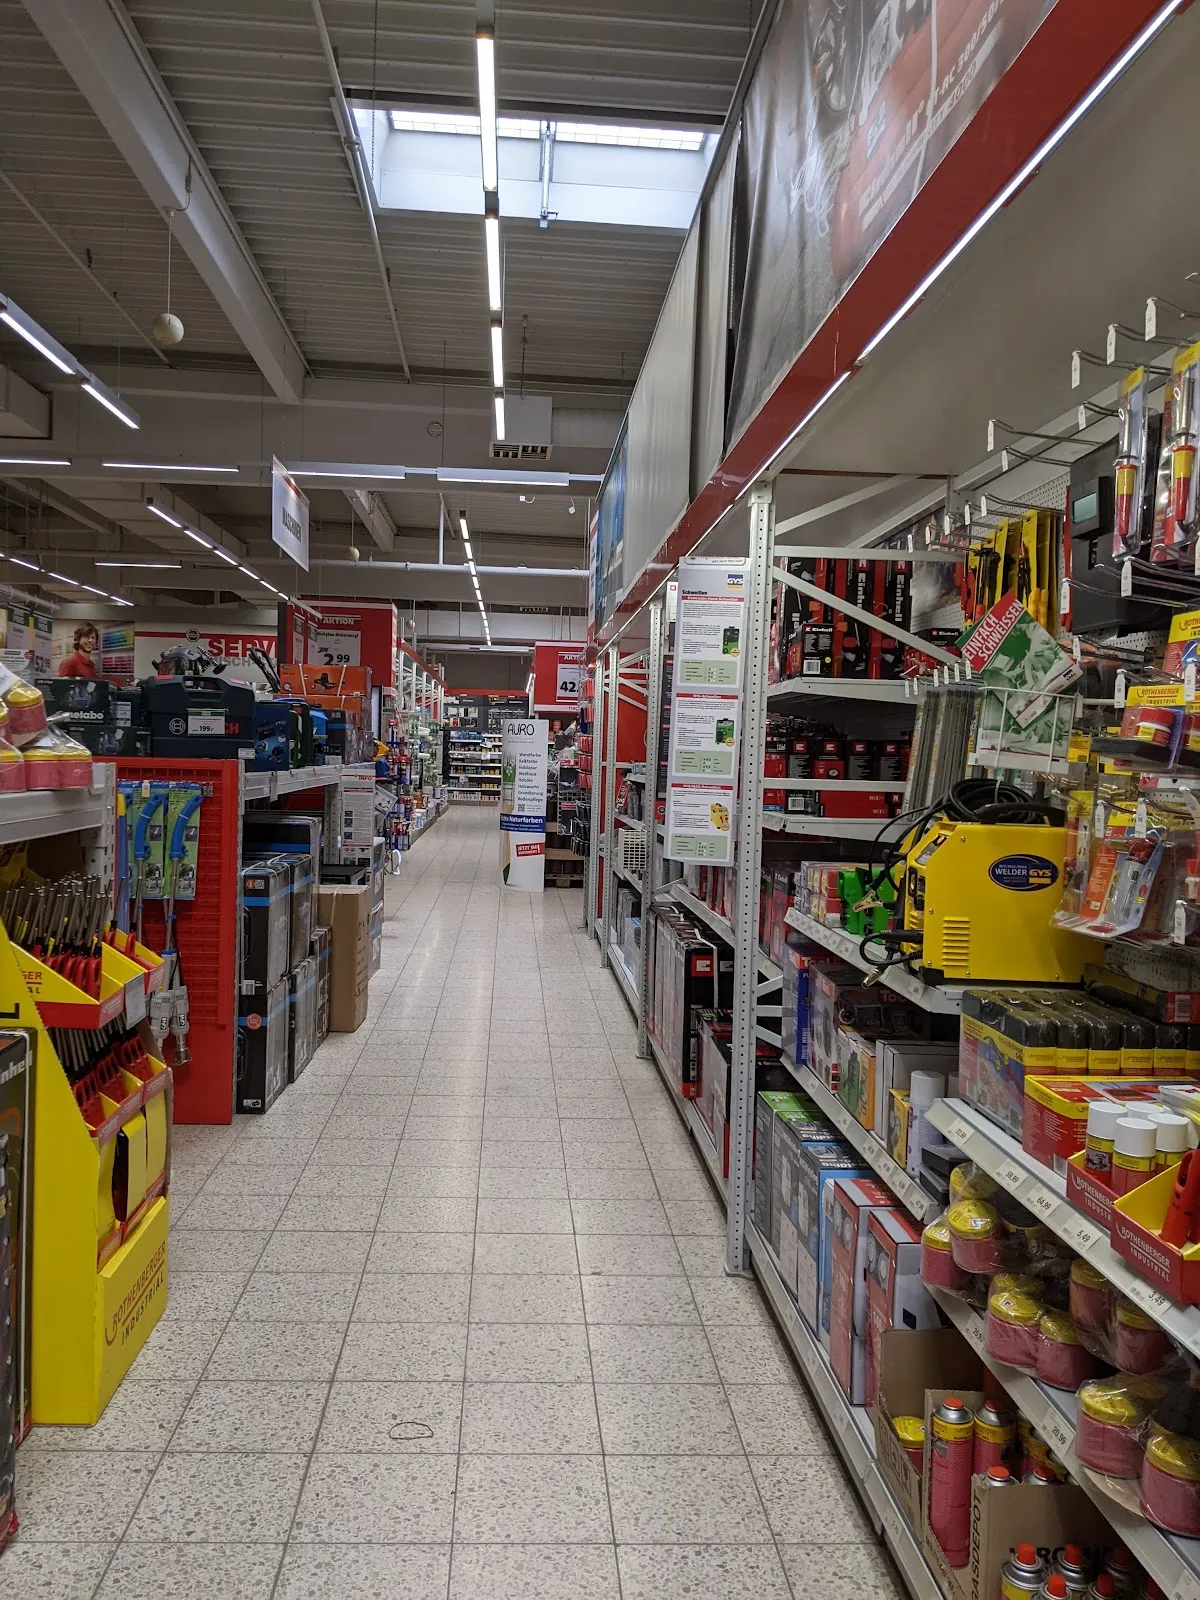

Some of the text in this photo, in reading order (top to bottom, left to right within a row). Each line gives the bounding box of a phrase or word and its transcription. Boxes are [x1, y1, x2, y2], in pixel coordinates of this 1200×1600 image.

[856, 572, 866, 609] Einh
[894, 574, 905, 622] Einhell
[962, 613, 999, 661] EINFACH
[977, 599, 1025, 662] SCHWEISSEN
[560, 681, 579, 693] 42.
[1140, 688, 1180, 696] ROTHENBERGER
[507, 723, 535, 736] AURO
[994, 868, 1052, 877] WELDER GYS
[1076, 1176, 1114, 1209] ROTHENBER
[1084, 1197, 1112, 1222] INDUSTR
[1120, 1226, 1170, 1268] ROTHENBERGER
[1130, 1247, 1170, 1282] INDUSTRIAL
[112, 1239, 166, 1332] ROTHENBERGER
[121, 1275, 165, 1345] INDUSTRIAL
